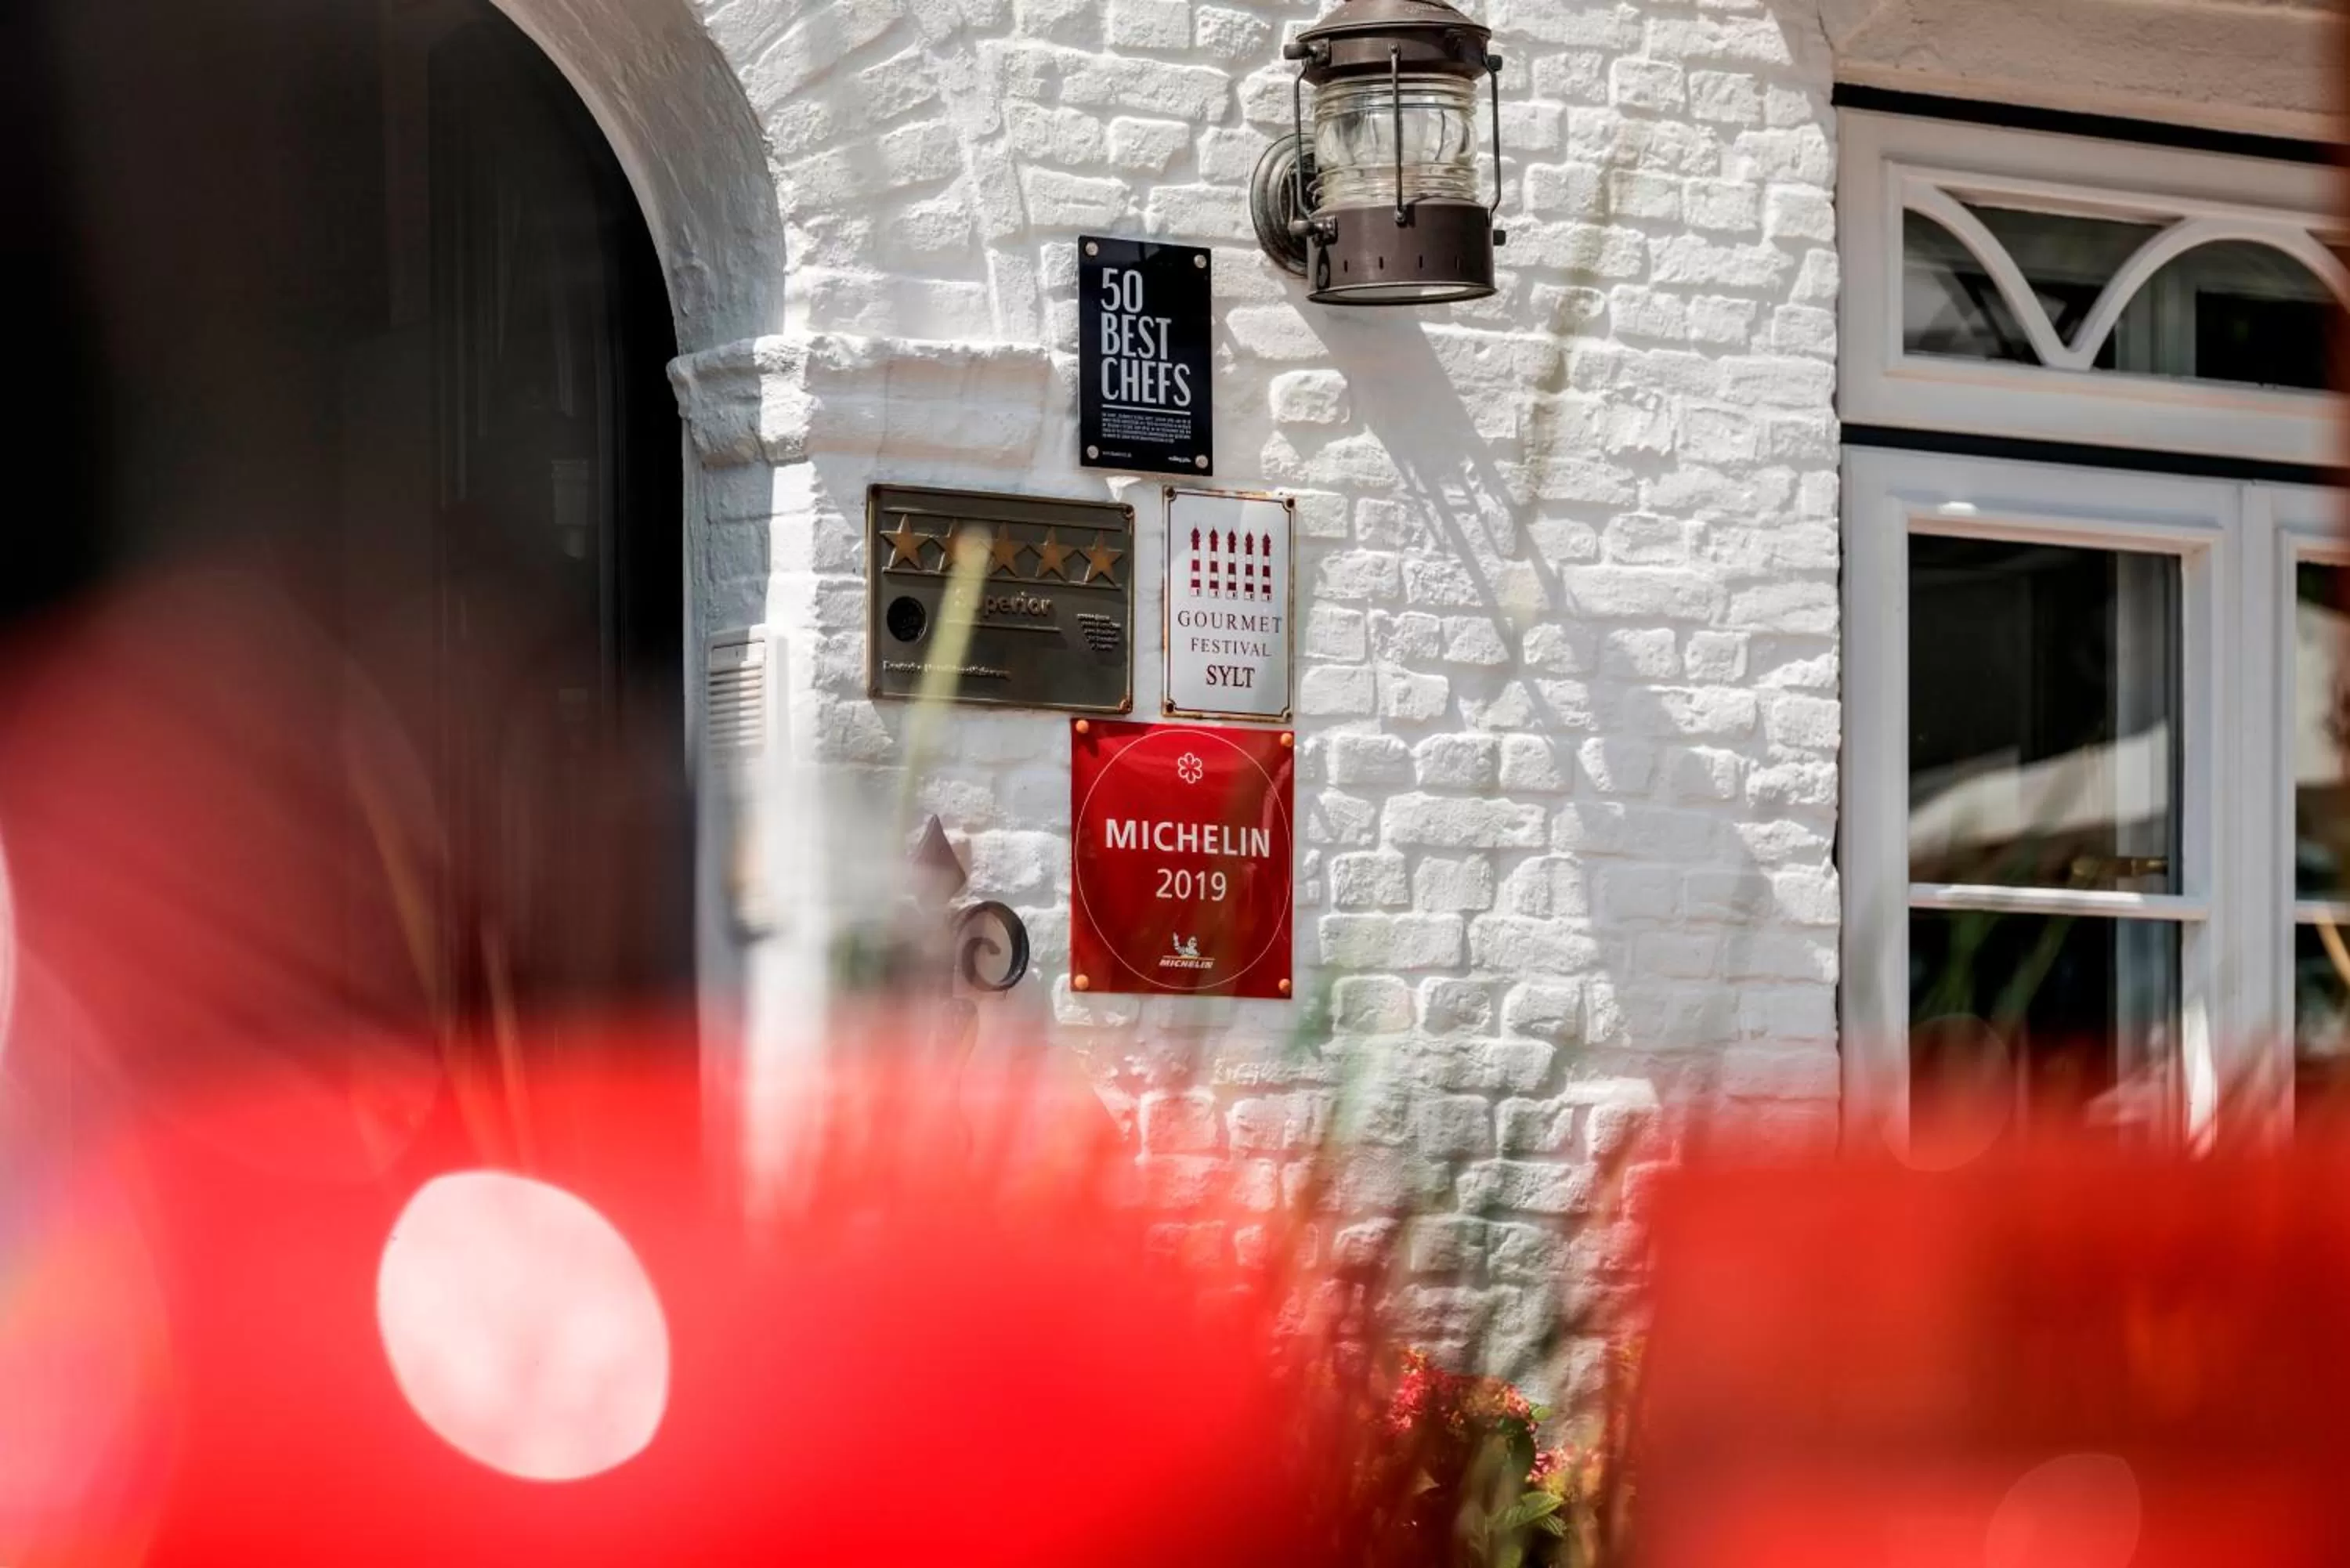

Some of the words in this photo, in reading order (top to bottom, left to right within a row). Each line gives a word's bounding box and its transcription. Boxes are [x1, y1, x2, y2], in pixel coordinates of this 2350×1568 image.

[1100, 267, 1144, 313] 50
[1101, 311, 1173, 360] BEST
[1101, 356, 1191, 407] CHEFS
[953, 588, 1053, 618] perior
[1177, 610, 1282, 634] GOURMET
[1190, 637, 1271, 658] FESTIVAL
[1206, 664, 1255, 688] SYLT
[1105, 818, 1271, 858] MICHELIN
[1155, 868, 1227, 901] 2019
[1159, 959, 1213, 969] MICHELIN
